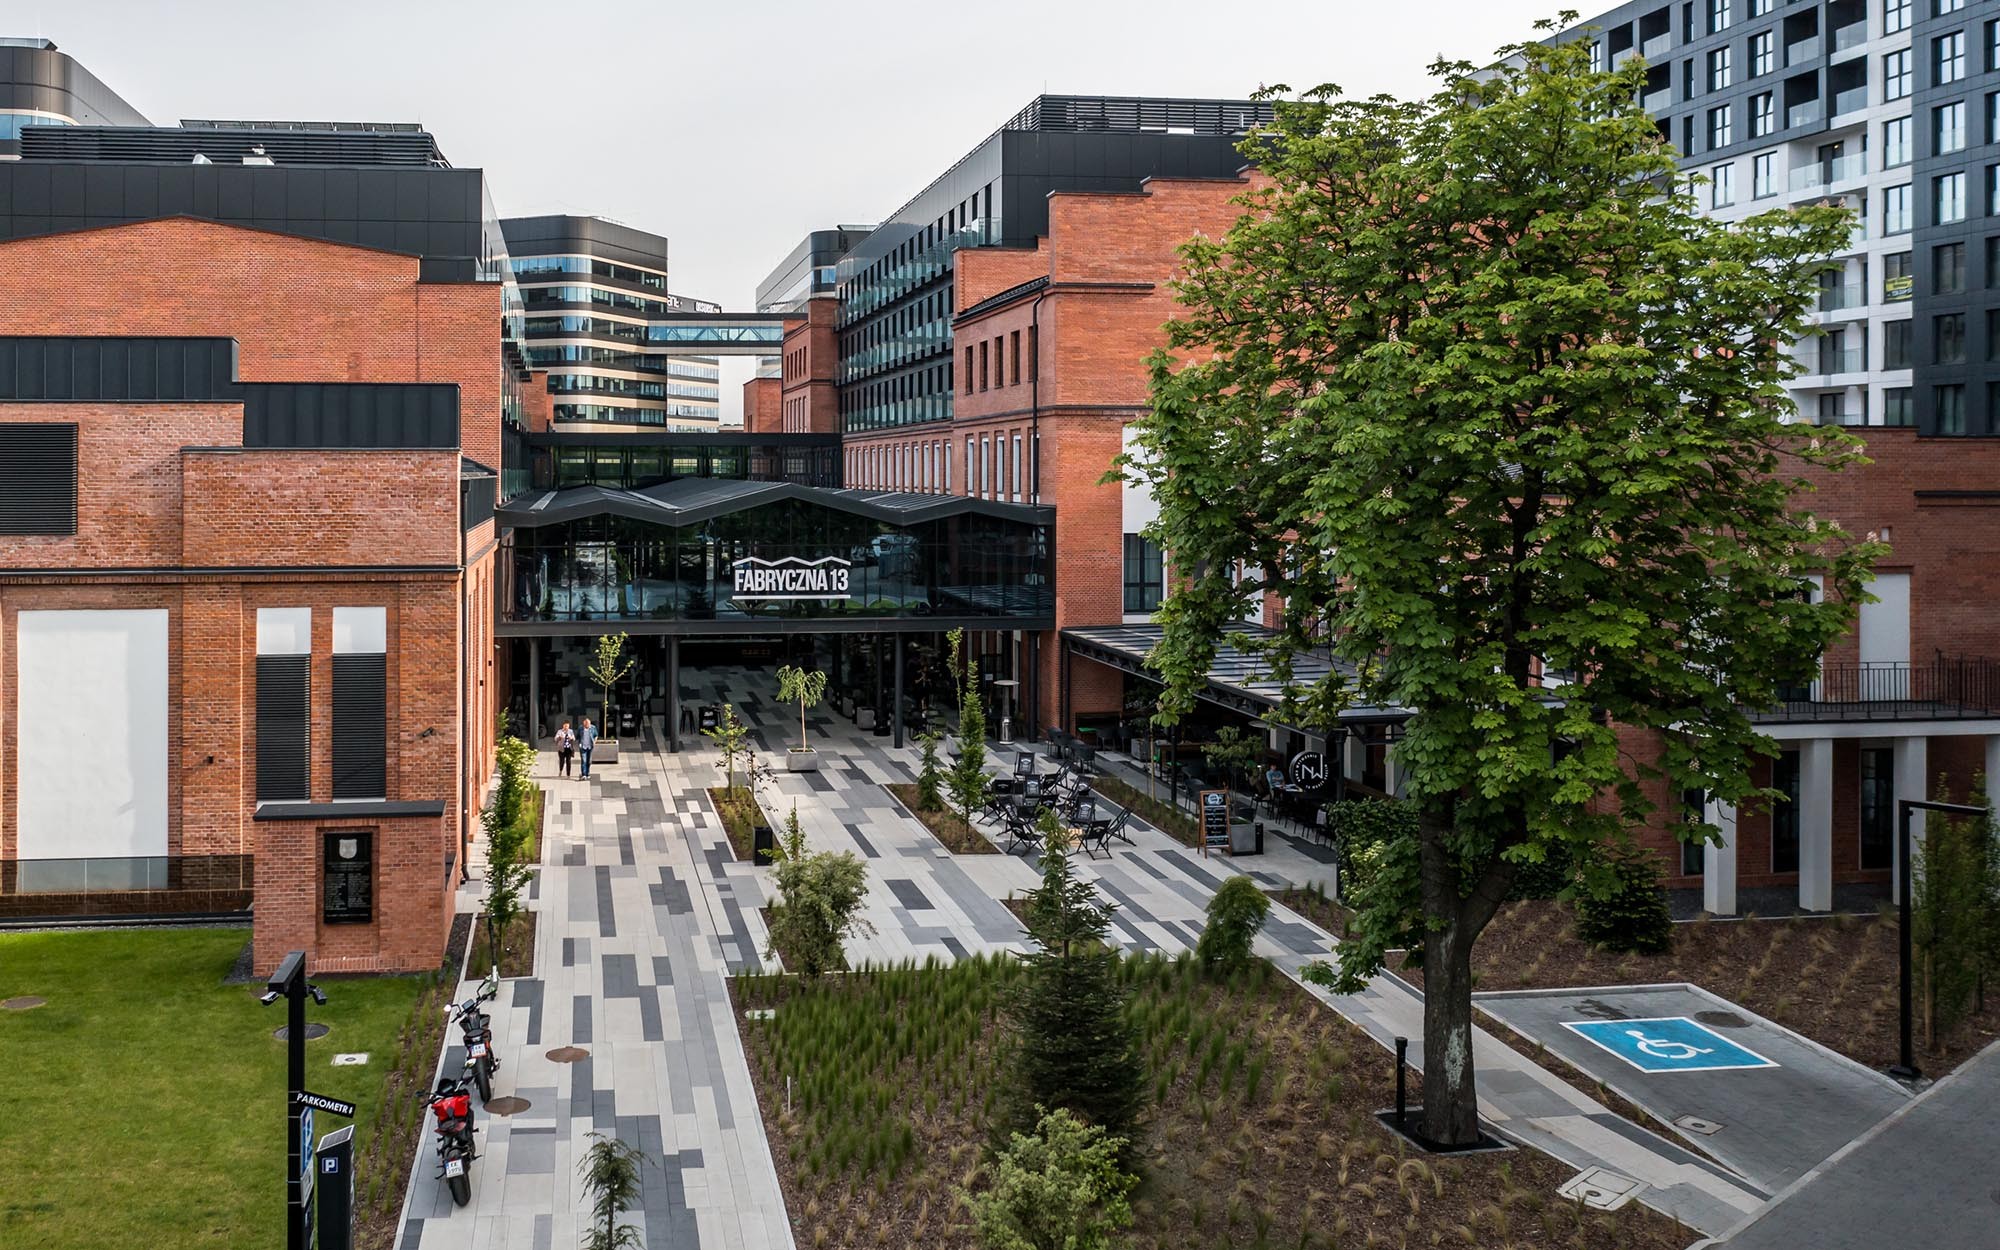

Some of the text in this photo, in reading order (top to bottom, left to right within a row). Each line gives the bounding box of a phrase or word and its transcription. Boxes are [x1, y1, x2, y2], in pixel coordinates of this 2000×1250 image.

[735, 569, 849, 592] FABRYCZNA 13
[296, 1093, 348, 1114] PARKOMETR
[325, 1159, 335, 1172] P
